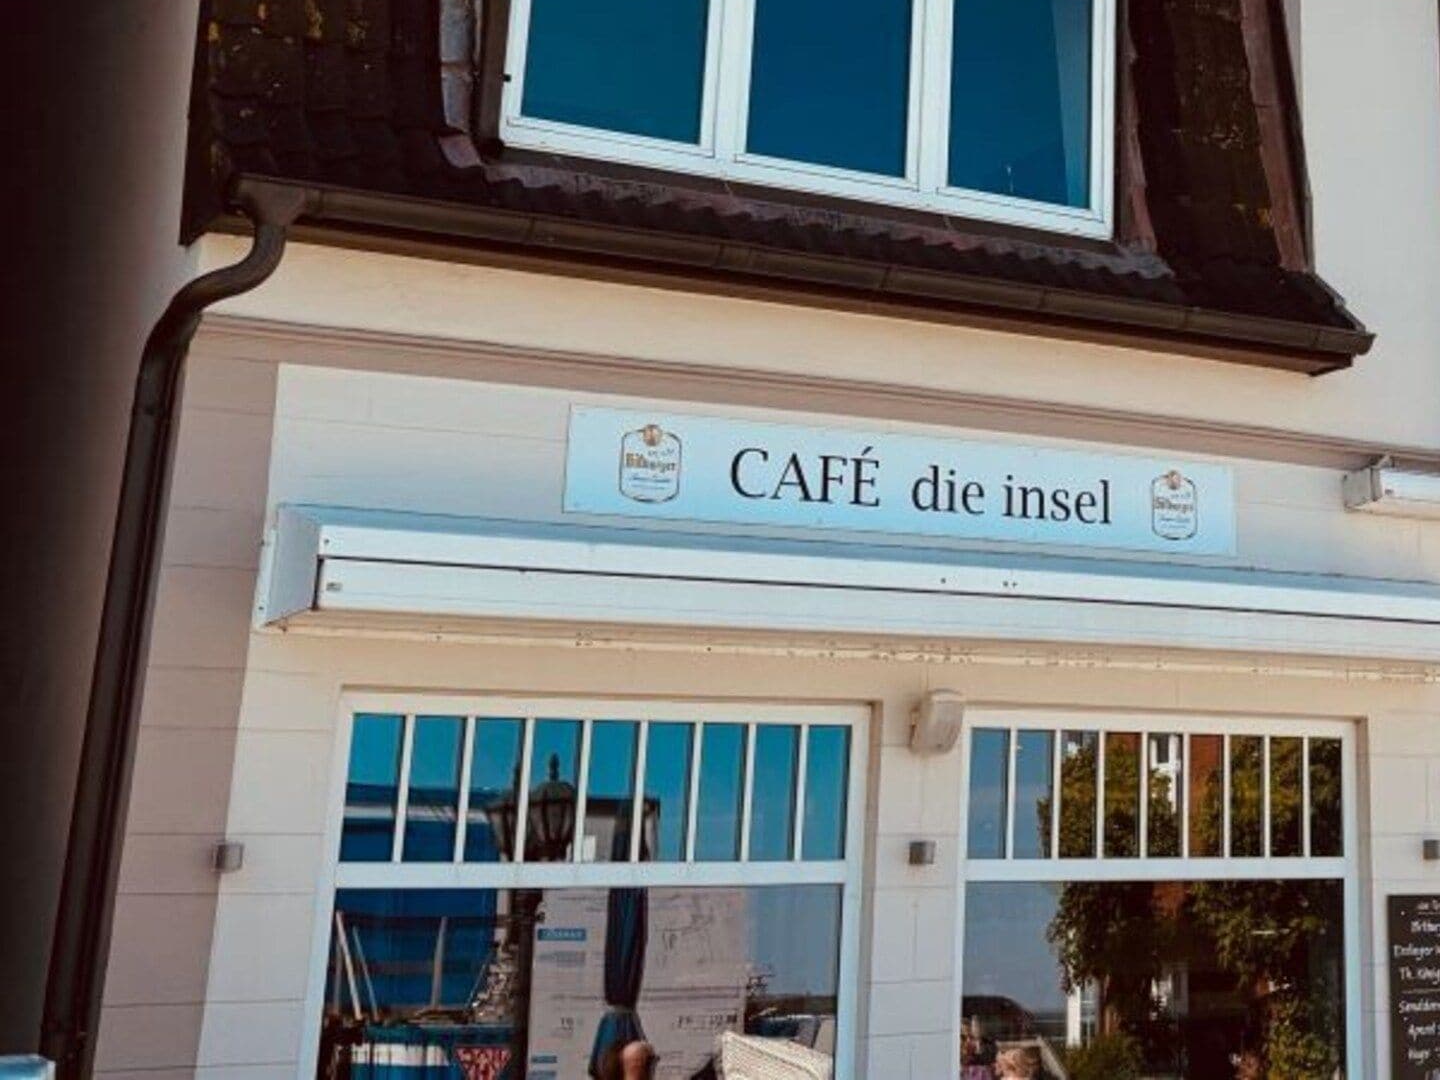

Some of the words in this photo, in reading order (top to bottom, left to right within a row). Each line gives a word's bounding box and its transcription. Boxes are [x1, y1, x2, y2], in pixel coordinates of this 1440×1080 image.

[730, 446, 881, 508] CAFÉ
[911, 464, 986, 515] die
[1002, 474, 1113, 524] insel
